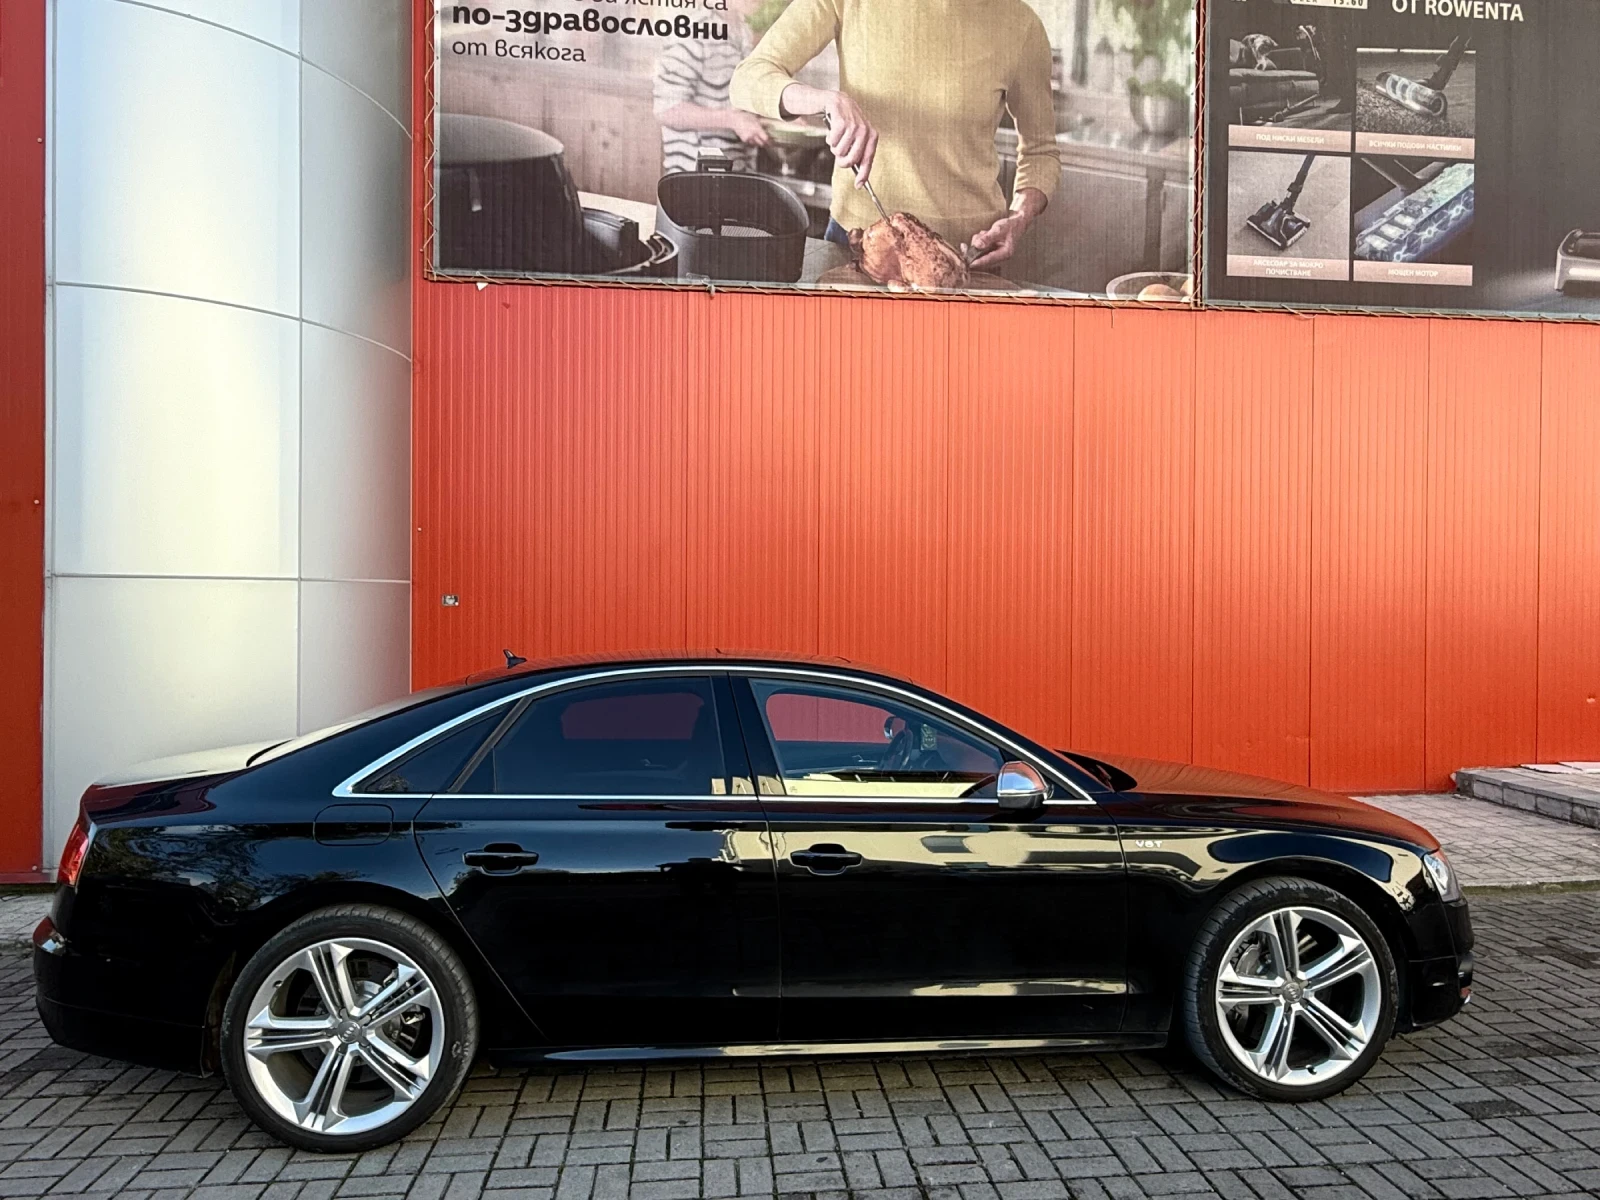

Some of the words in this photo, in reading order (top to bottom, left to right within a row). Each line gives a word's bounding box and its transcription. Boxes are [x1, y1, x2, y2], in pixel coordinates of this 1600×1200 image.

[1425, 0, 1524, 22] ROWENTA
[452, 5, 728, 41] по-здравословни
[452, 40, 487, 56] от
[494, 39, 586, 62] всякога
[1265, 268, 1312, 277] ПОЧИСТВАНЕ
[1415, 269, 1439, 277] МОТОР
